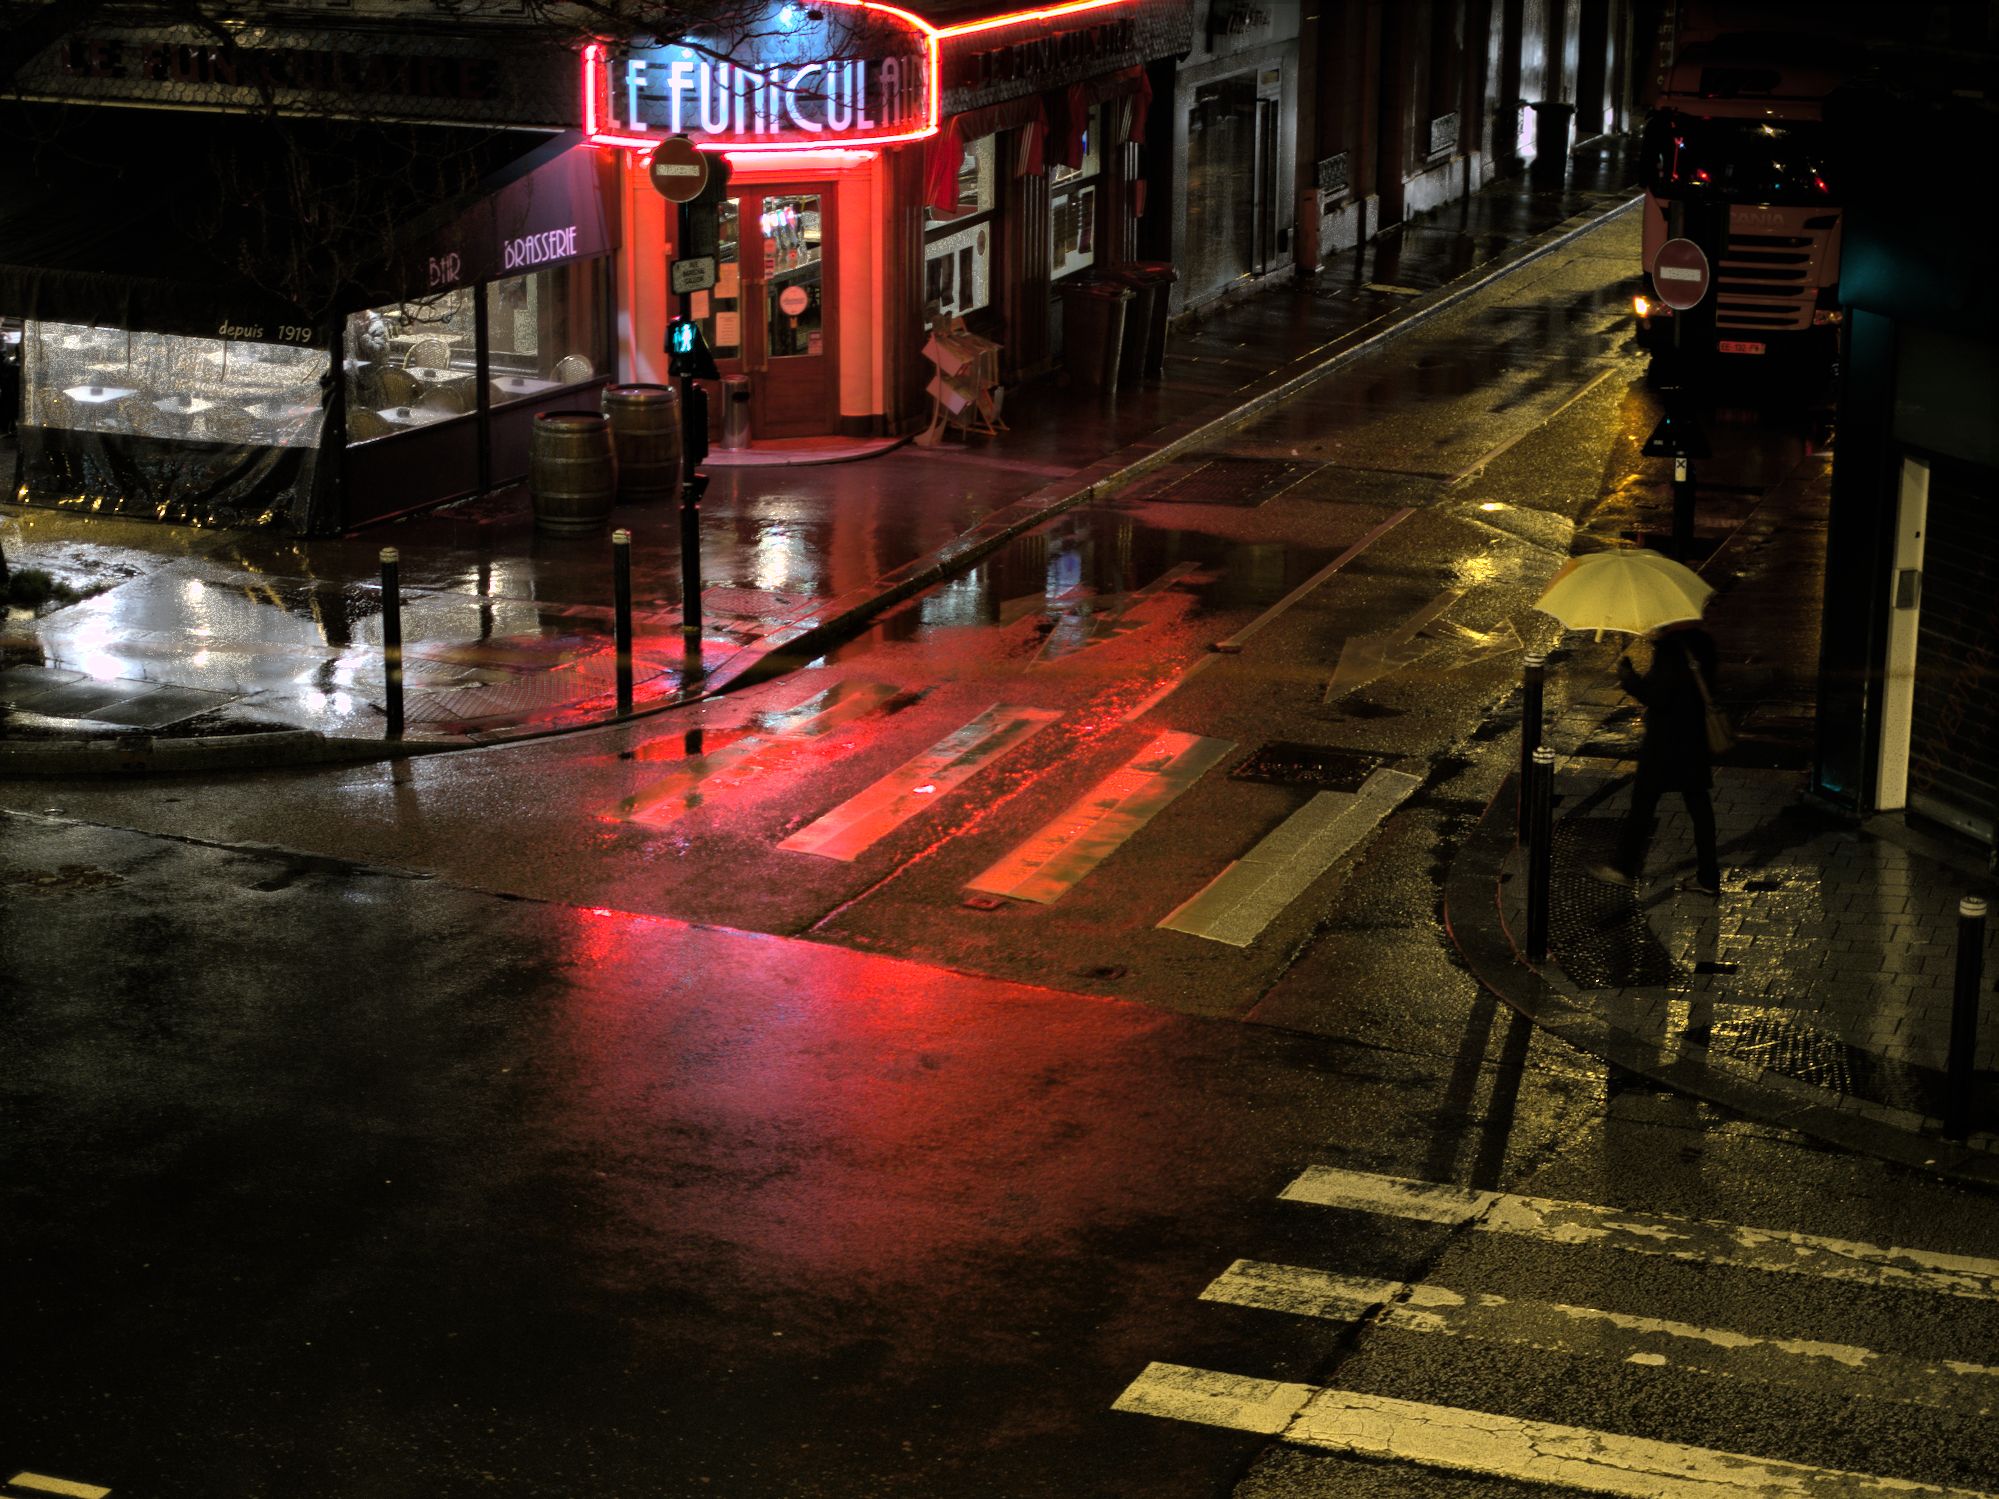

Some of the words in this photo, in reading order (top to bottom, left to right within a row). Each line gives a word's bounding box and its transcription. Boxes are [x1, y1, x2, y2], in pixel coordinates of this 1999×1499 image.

[606, 59, 649, 132] LE
[428, 252, 461, 287] BAR
[504, 226, 577, 269] BRASSERIE
[219, 320, 264, 340] depuis
[278, 325, 312, 342] 1919
